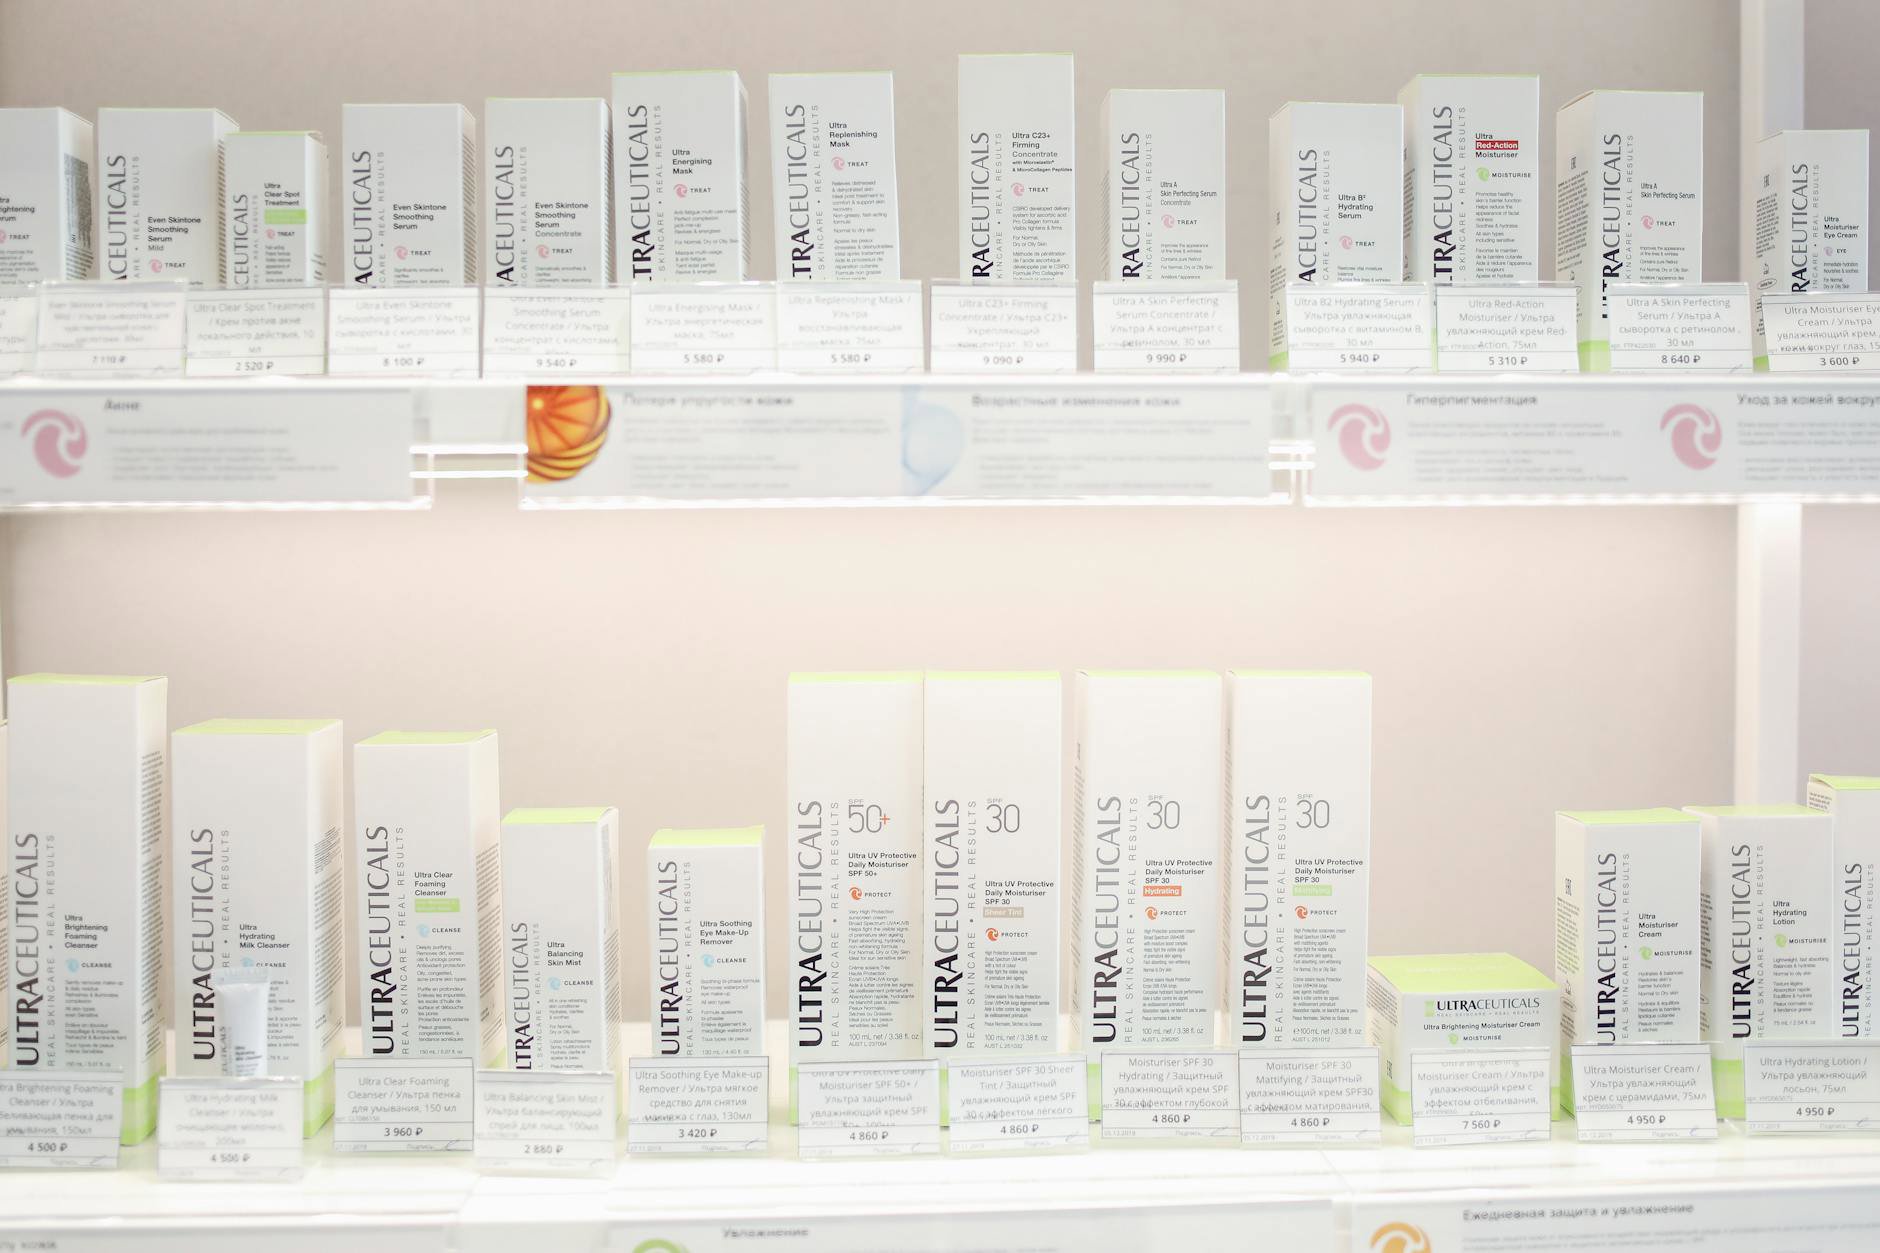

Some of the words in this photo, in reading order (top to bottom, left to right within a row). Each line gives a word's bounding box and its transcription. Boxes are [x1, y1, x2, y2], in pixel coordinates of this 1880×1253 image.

[829, 131, 878, 139] Replenishing
[1012, 141, 1040, 149] Firming
[1475, 142, 1519, 150] Red-Action
[672, 158, 712, 166] Energising
[1458, 165, 1466, 194] REAL
[1173, 190, 1199, 198] Perfecting
[413, 203, 447, 211] Skintone
[1338, 203, 1373, 212] Hydrating
[393, 213, 434, 221] Smoothing
[1824, 232, 1836, 240] Eye
[1469, 299, 1492, 308] Ultra
[1494, 299, 1544, 309] Red-Action
[1116, 311, 1148, 319] Serum
[1150, 310, 1209, 319] Concentrate
[1619, 326, 1671, 336] сыворотка
[1673, 326, 1679, 334] с
[1681, 325, 1733, 337] ретинолом
[1489, 356, 1495, 366] 5
[1498, 356, 1517, 366] 310
[1661, 355, 1668, 364] 8
[1671, 355, 1690, 364] 640
[986, 804, 1020, 833] 30
[1146, 800, 1180, 830] 30
[848, 861, 866, 869] Daily
[868, 861, 909, 869] Moisturiser
[414, 880, 446, 888] Foaming
[1144, 887, 1180, 895] Hydrating
[1773, 909, 1807, 917] Hydrating
[719, 920, 752, 928] Soothing
[798, 802, 827, 1047] ULTRACEUTICALS
[1092, 797, 1122, 1043] ULTRACEUTICALS
[64, 924, 108, 932] Brightening
[64, 933, 97, 941] Foaming
[239, 933, 275, 941] Hydrating
[700, 929, 713, 937] Eye
[191, 829, 216, 1060] ULTRACEUTICALS
[366, 826, 398, 1054] ULTRACEUTICALS
[1732, 845, 1755, 1038] ULTRACEUTICALS
[15, 834, 43, 1066] ULTRACEUTICALS
[547, 950, 583, 958] Balancing
[658, 862, 683, 1055] ULTRACEUTICALS
[1437, 998, 1540, 1012] ULTRACEUTICALS
[1481, 1021, 1518, 1029] Moisturiser
[1129, 1057, 1181, 1067] Moisturiser
[1183, 1057, 1199, 1067] SPF
[1202, 1057, 1214, 1067] 30
[1760, 1057, 1782, 1066] Ultra
[1785, 1057, 1830, 1067] Hydrating
[1831, 1057, 1861, 1066] Lotion
[635, 1071, 658, 1080] Ultra
[660, 1070, 702, 1080] Soothing
[703, 1070, 720, 1080] Eye
[721, 1070, 762, 1080] Make-up
[1761, 1071, 1795, 1081] Ультра
[1796, 1069, 1867, 1081] увлажняющий
[1245, 1087, 1316, 1098] увлажняющий
[1318, 1089, 1343, 1098] крем
[1345, 1087, 1373, 1097] SPF30
[1822, 1084, 1846, 1094] 75мл
[1582, 1094, 1606, 1103] крем
[1609, 1094, 1614, 1102] с
[1682, 1091, 1707, 1101] 75мл
[351, 1105, 369, 1114] для
[425, 1103, 441, 1114] 150
[1796, 1107, 1802, 1116] 4
[1805, 1107, 1824, 1116] 950
[1152, 1115, 1158, 1123] 4
[1161, 1114, 1180, 1123] 860
[384, 1127, 390, 1137] 3
[393, 1127, 412, 1137] 960
[1463, 1209, 1546, 1221] Ежедневная
[1550, 1208, 1597, 1219] защита
[1601, 1208, 1609, 1216] и
[1612, 1204, 1694, 1218] увлажнение
